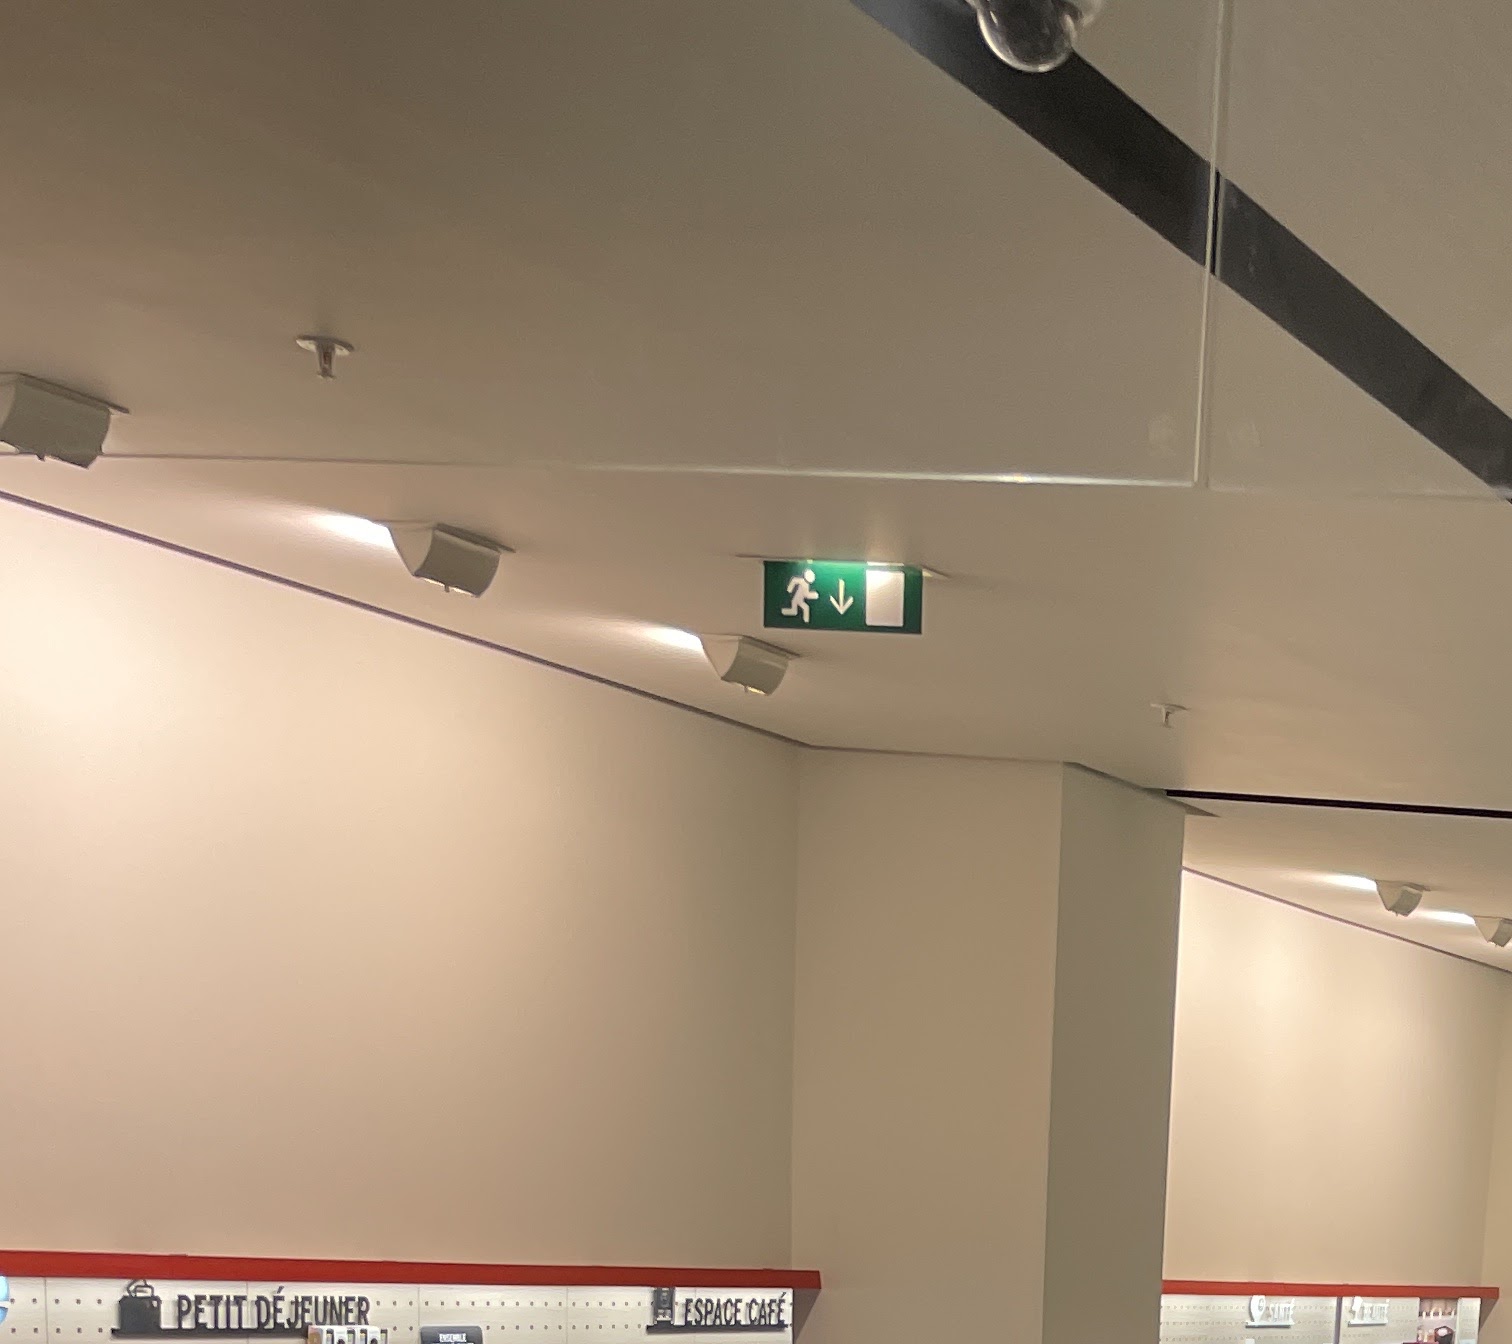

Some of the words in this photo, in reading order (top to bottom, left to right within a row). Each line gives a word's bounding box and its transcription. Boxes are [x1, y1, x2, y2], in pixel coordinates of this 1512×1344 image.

[177, 1294, 247, 1329] PETIT
[255, 1286, 370, 1328] DÉJEUNER
[685, 1299, 742, 1325] ESPACE
[750, 1292, 787, 1325] CAFÉ
